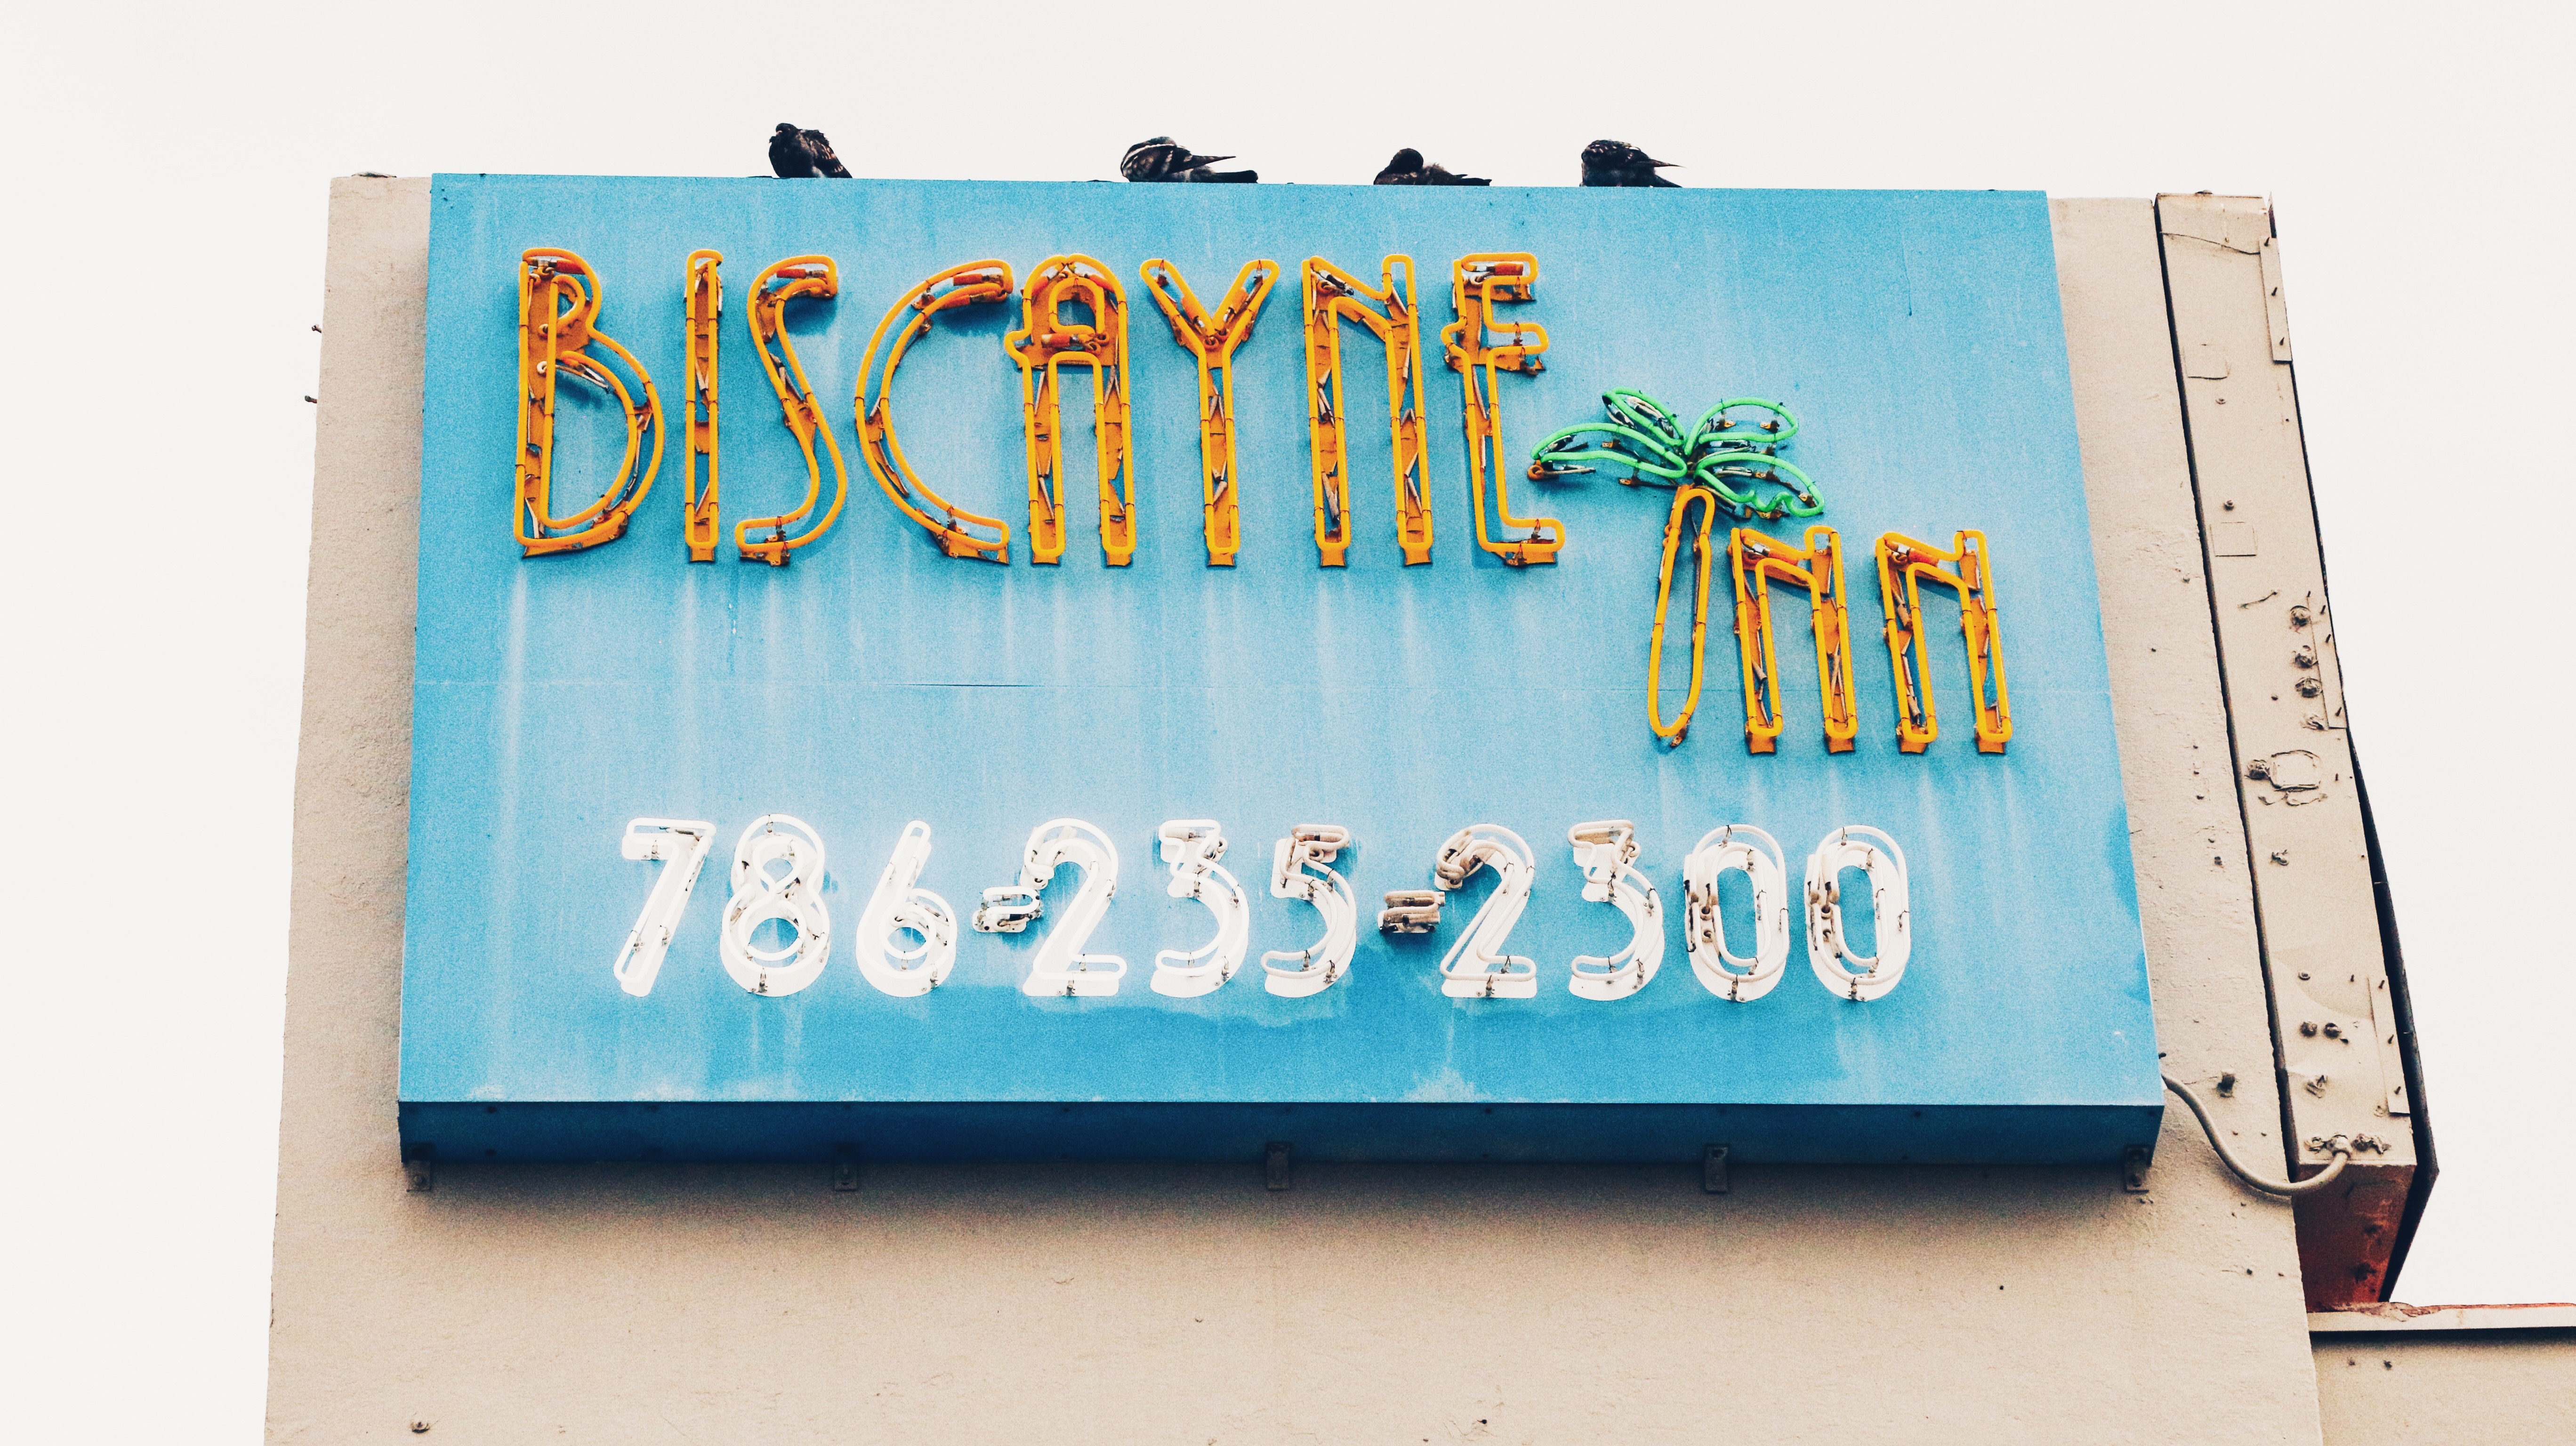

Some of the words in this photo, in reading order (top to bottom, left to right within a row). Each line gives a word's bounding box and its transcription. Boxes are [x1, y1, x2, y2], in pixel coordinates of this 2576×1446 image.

[513, 248, 1566, 568] BISCAYNE
[1648, 484, 2012, 754] INN
[613, 813, 1911, 1002] 786-235-2300
